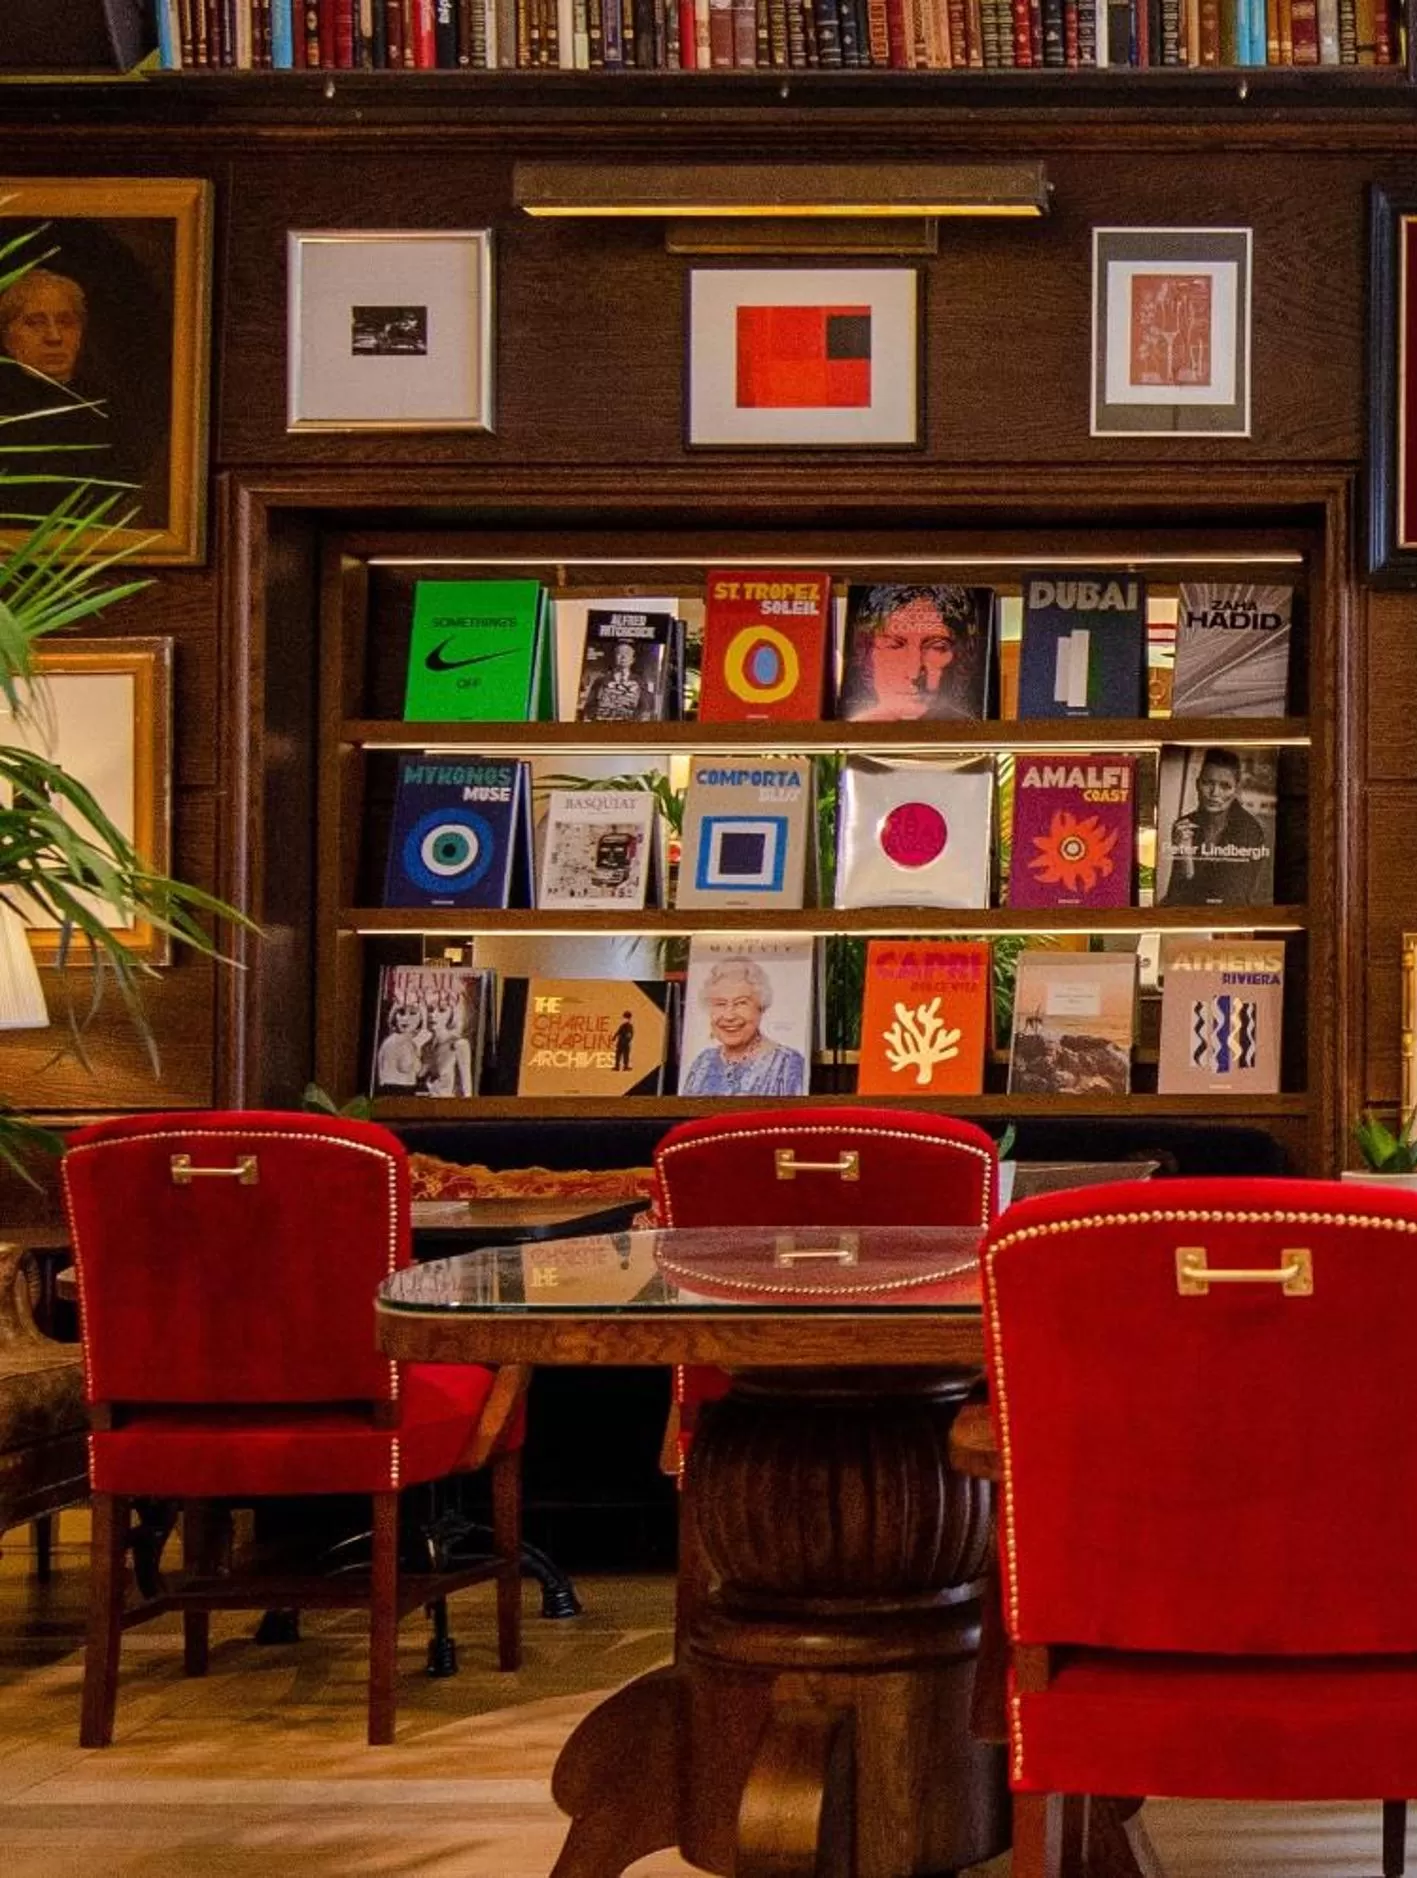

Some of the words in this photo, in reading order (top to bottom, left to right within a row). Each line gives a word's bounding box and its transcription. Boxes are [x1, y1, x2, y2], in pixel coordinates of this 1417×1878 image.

[743, 583, 820, 600] TROPEZ
[1029, 581, 1138, 610] DUBAI
[761, 601, 820, 615] SOLEIL
[1211, 601, 1257, 611] ZAHA
[611, 613, 647, 626] ALFRED
[1186, 611, 1282, 630] HADID
[404, 765, 512, 786] MYKONOS
[696, 768, 801, 787] COMPORTA
[1021, 766, 1129, 788] AMALFI
[463, 787, 511, 801] MUSE
[1082, 788, 1129, 802] COAST
[565, 798, 637, 811] BASQUIAT
[1201, 843, 1270, 860] Lindbergh
[1171, 952, 1282, 972] ATHENS
[1222, 971, 1281, 985] RIVIERA
[533, 996, 564, 1014] THE
[533, 1015, 611, 1033] CHARLIE
[530, 1032, 613, 1050] CHAPLIN
[528, 1050, 616, 1068] ARCHIVES
